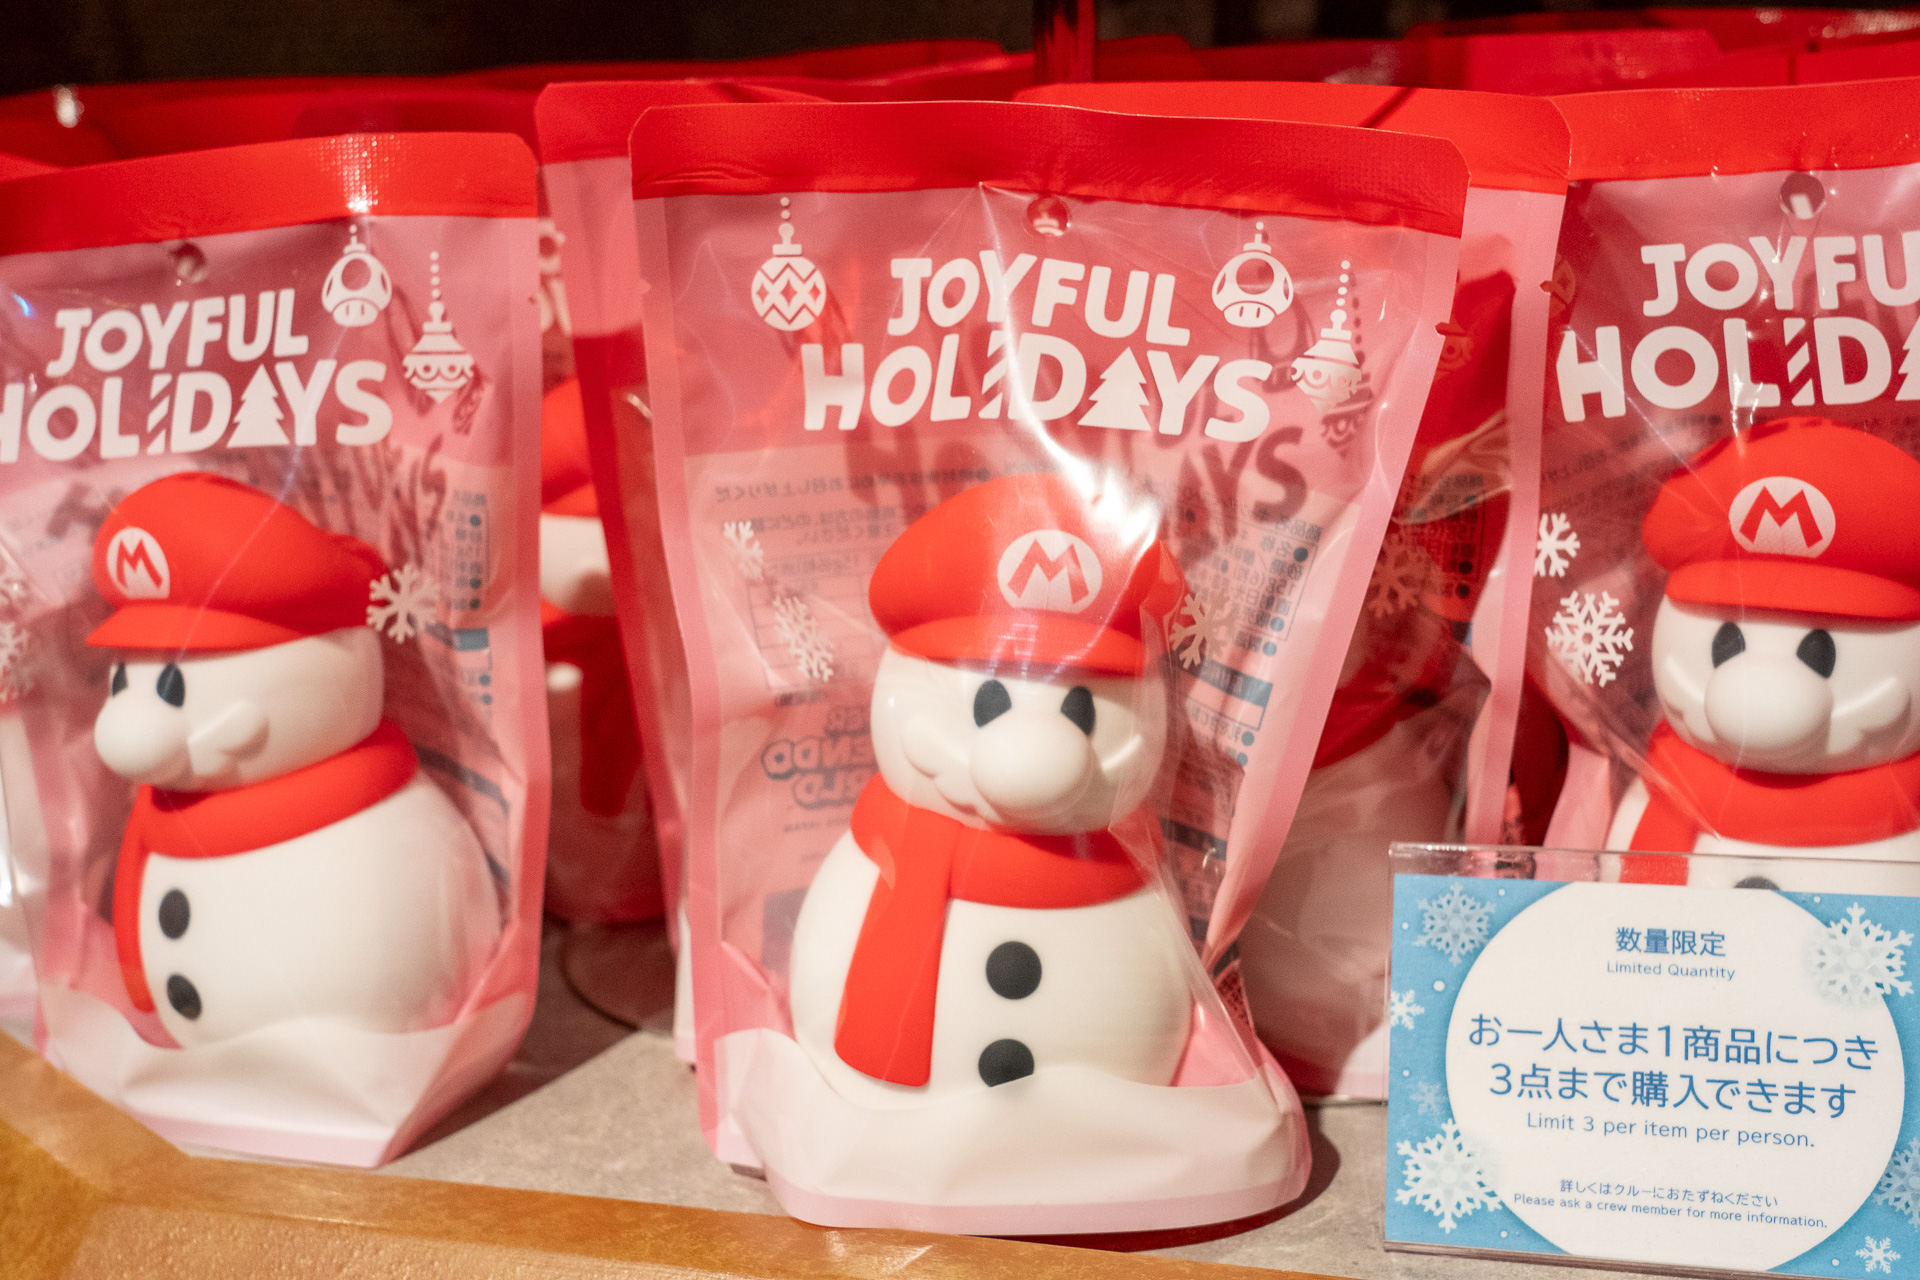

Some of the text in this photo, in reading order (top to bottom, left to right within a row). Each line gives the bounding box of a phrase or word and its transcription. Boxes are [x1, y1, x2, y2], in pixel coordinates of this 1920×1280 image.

[887, 250, 1191, 346] JOYFUL
[46, 288, 309, 377] JOYFUL
[801, 331, 1273, 442] HOLIDAYS
[1615, 926, 1727, 957] 数量限定
[1607, 961, 1736, 982] Limited Quantity
[1469, 1013, 1879, 1071] お一人さま1商品につき
[1489, 1062, 1857, 1119] 3点まで購入できます
[1527, 1111, 1815, 1148] Limit 3 per item per person.
[1513, 1193, 1828, 1229] Please ask a crew member for more information.
[1560, 1178, 1779, 1208] 詳しくはクルーにおたずねください
